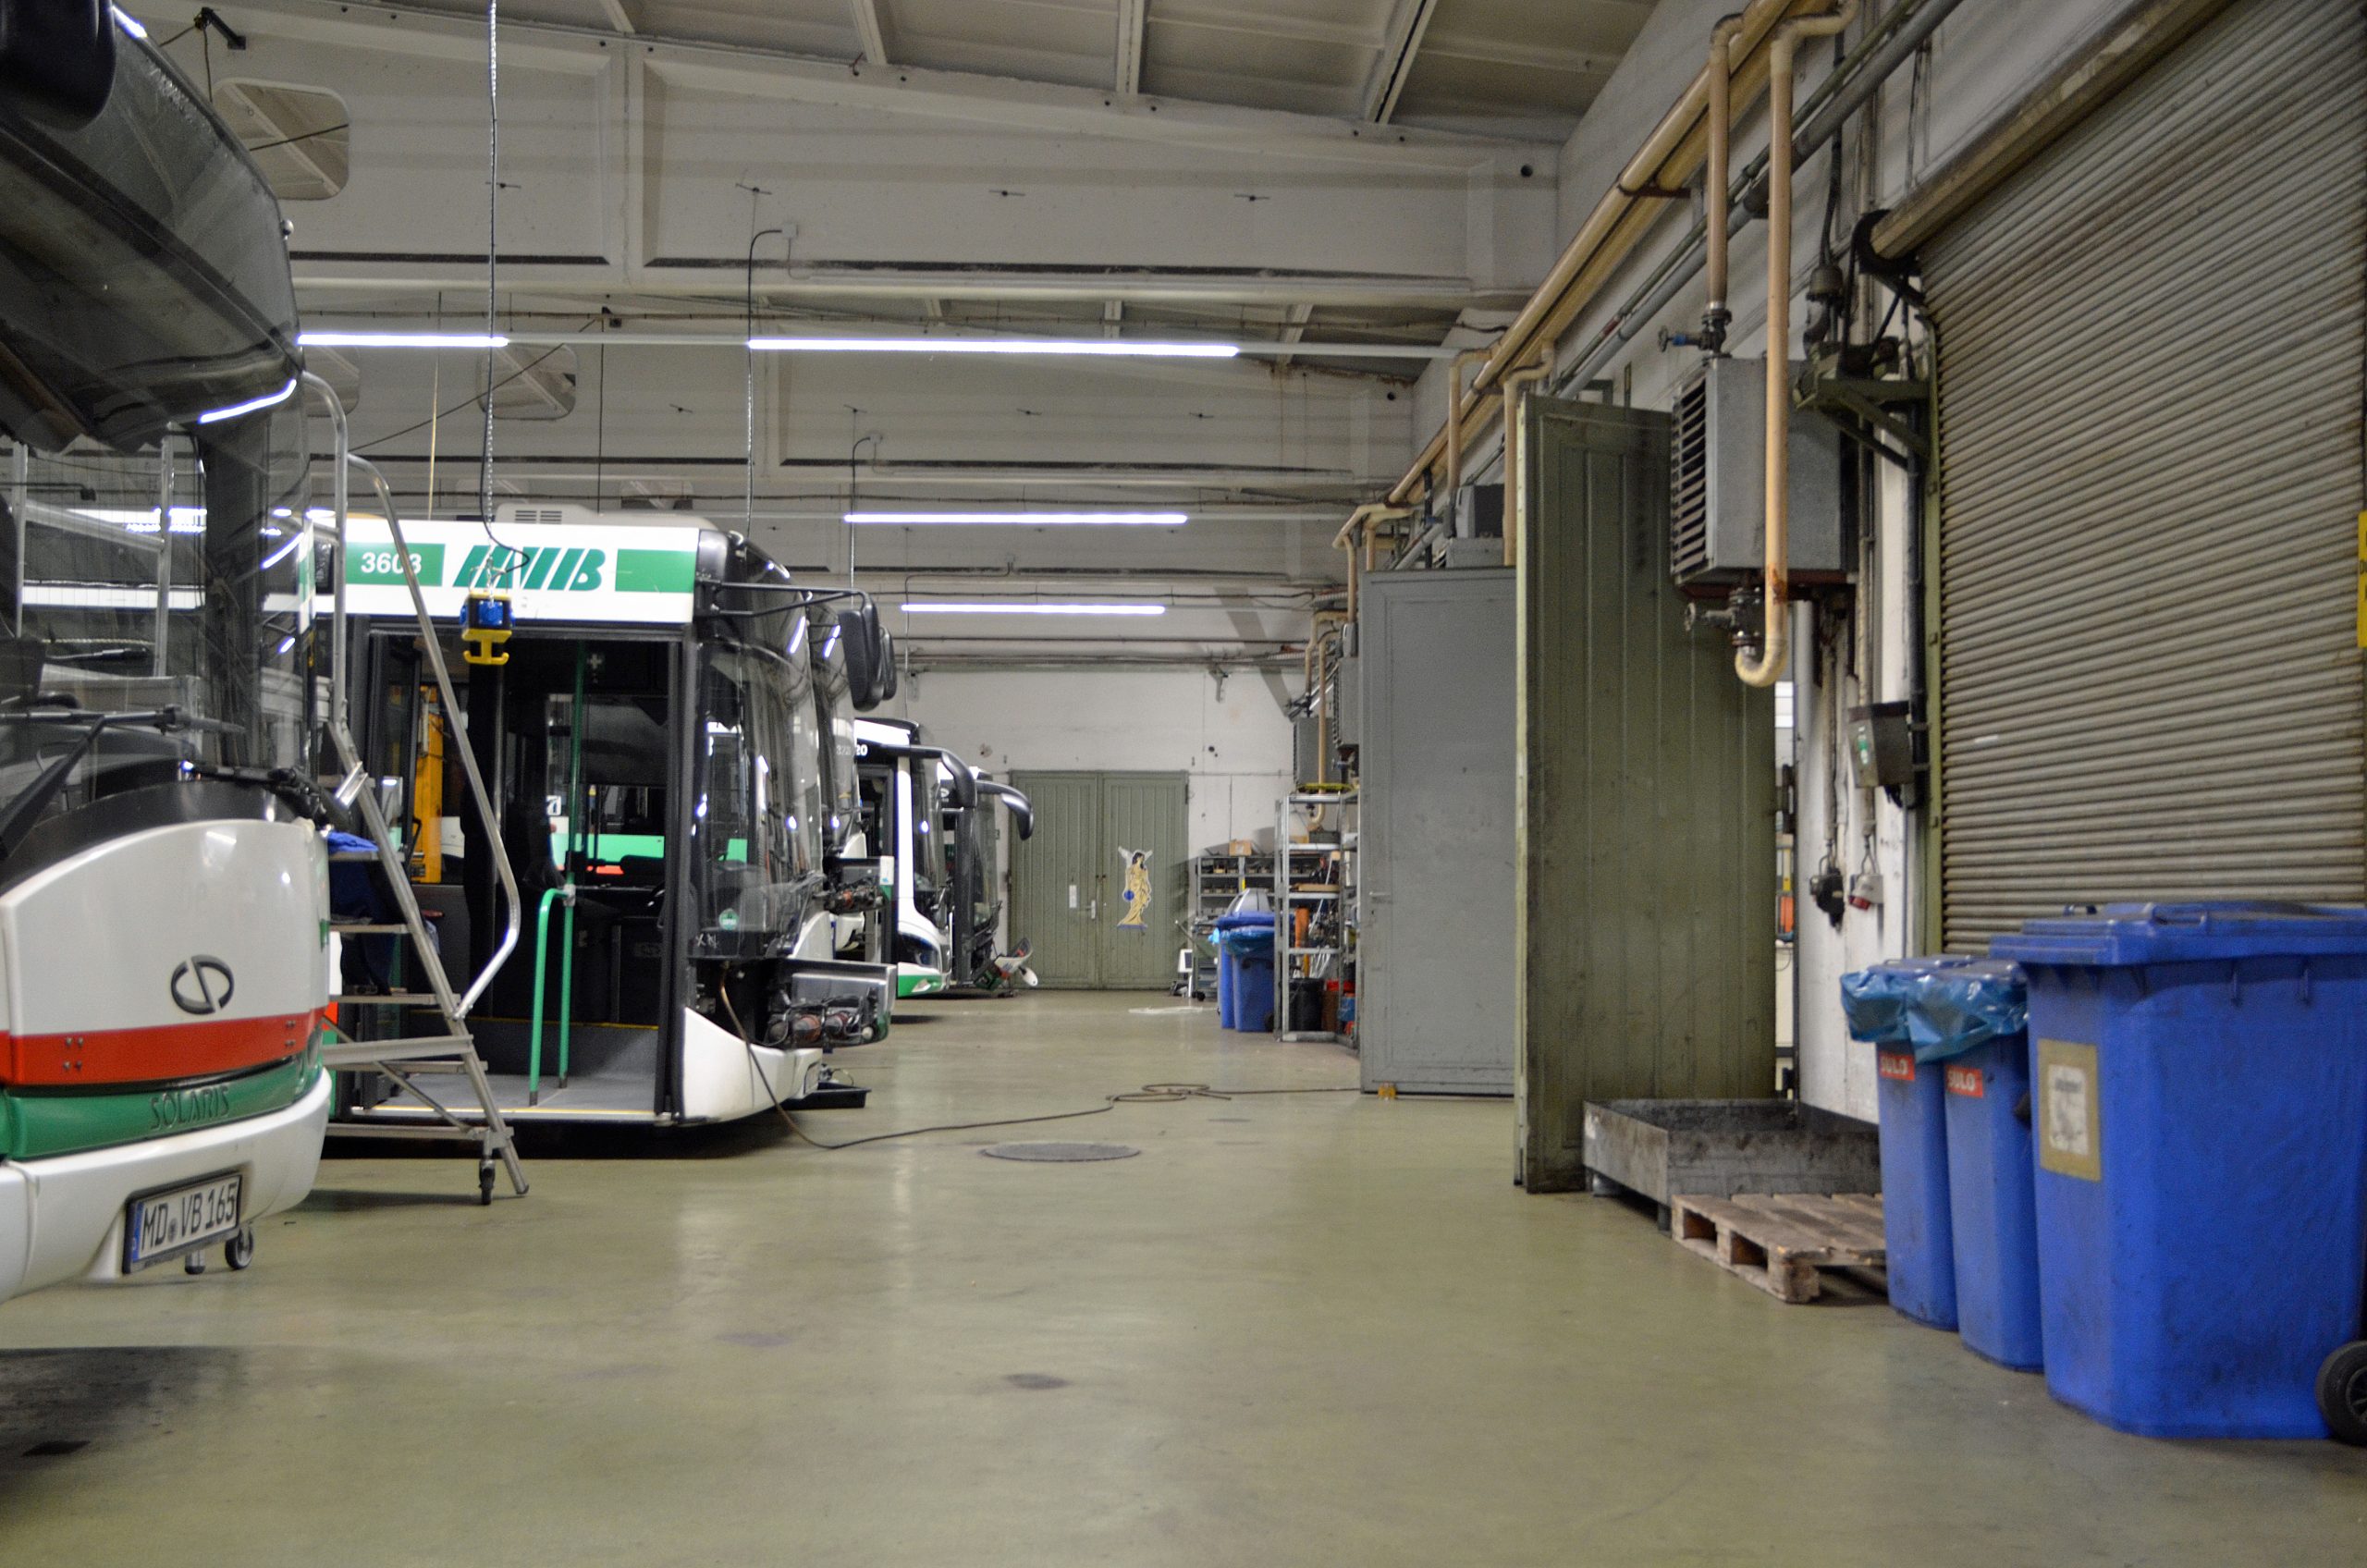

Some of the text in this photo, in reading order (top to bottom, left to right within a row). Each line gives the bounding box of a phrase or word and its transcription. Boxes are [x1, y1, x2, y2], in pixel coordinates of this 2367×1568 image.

[361, 552, 422, 574] 3603
[1947, 1069, 1976, 1092] SULO
[150, 1085, 229, 1129] SOLARIS
[205, 1182, 238, 1231] 165
